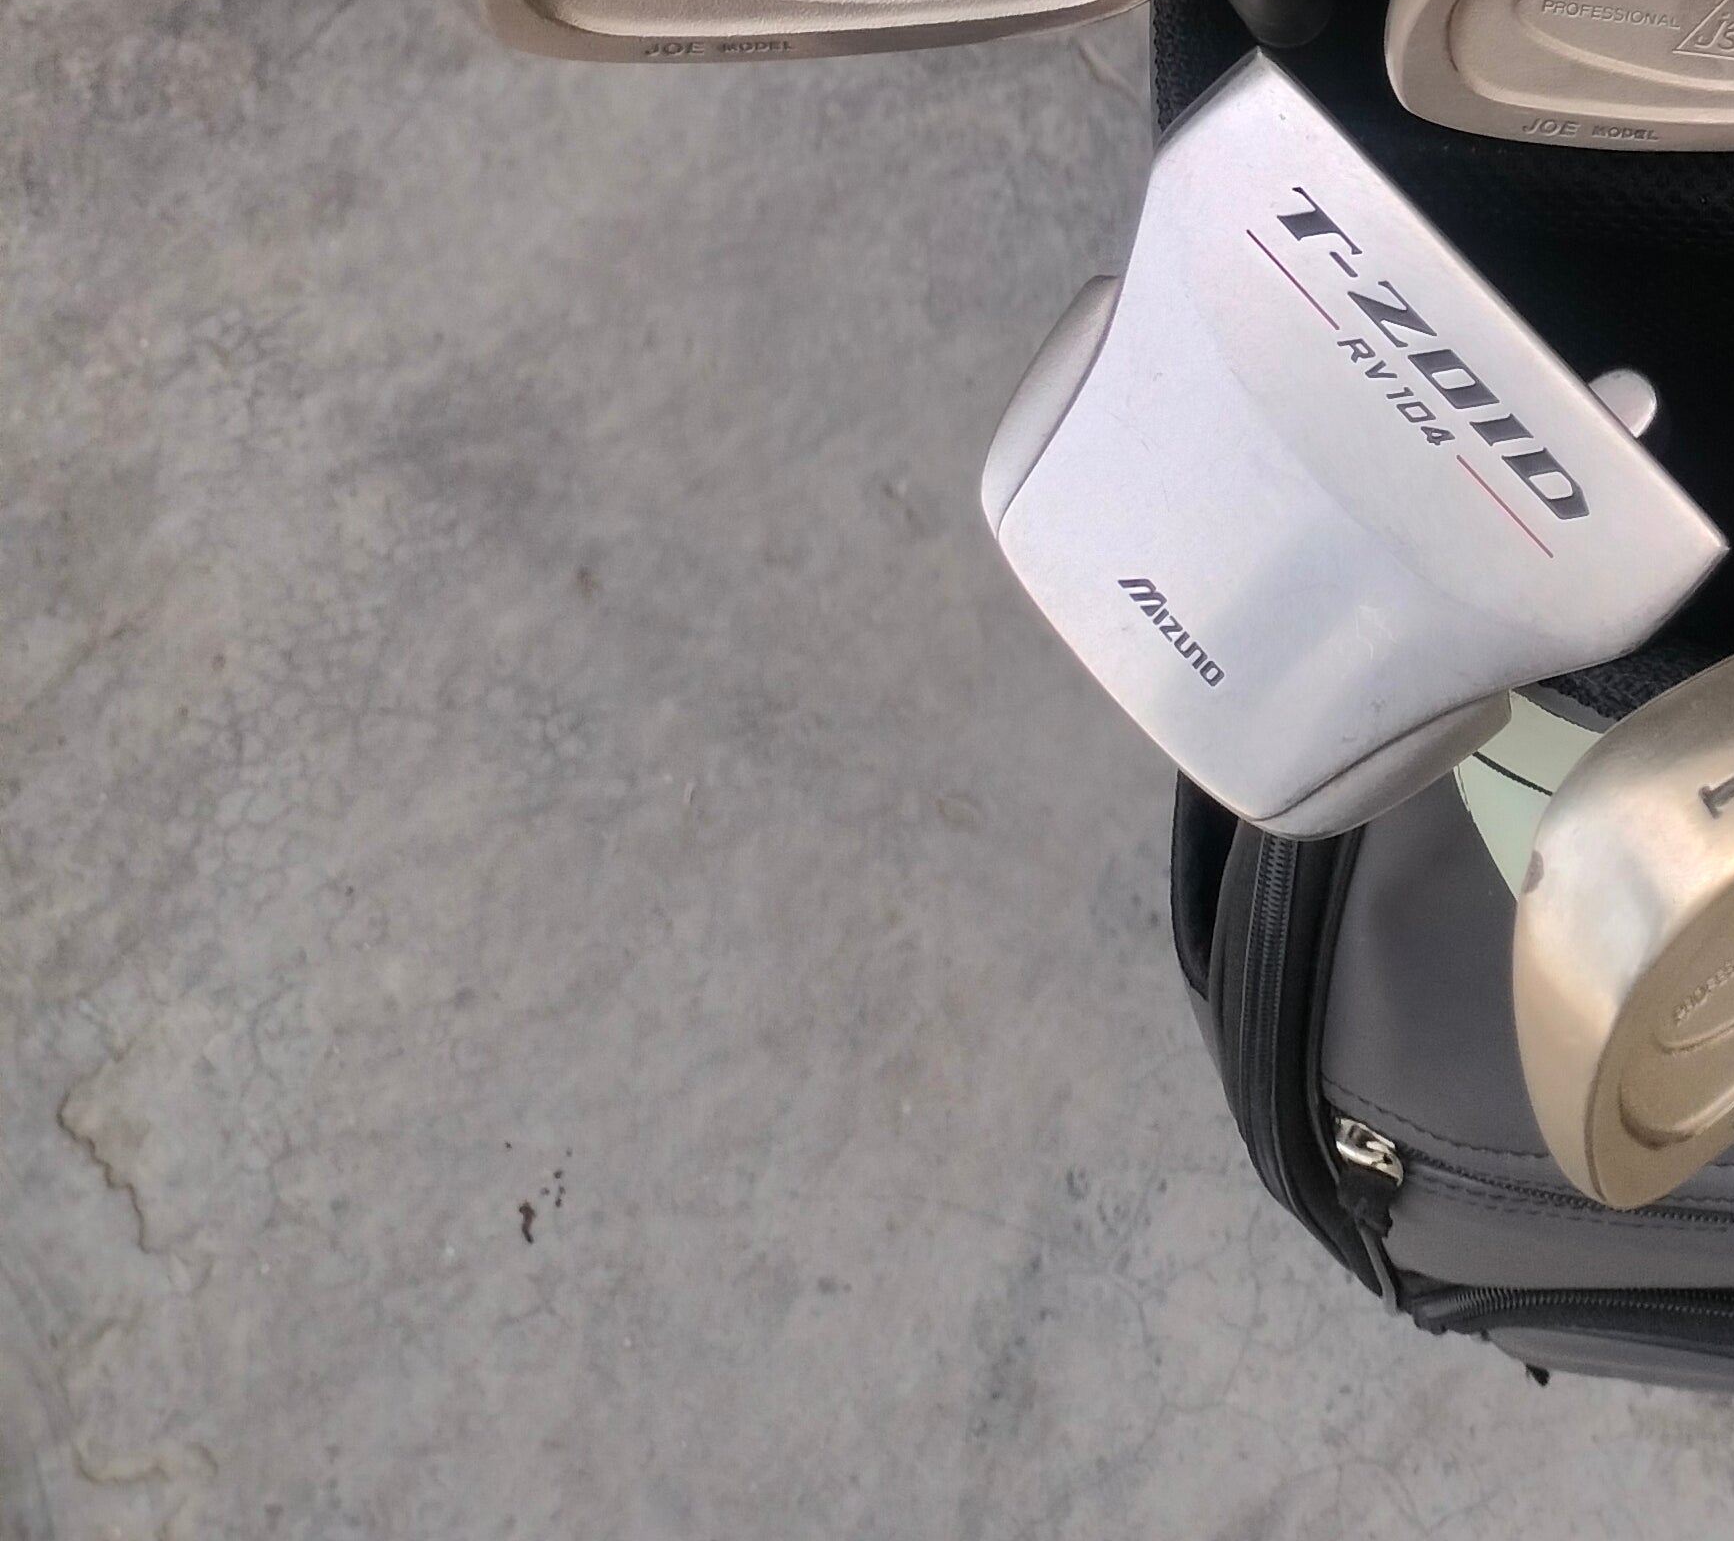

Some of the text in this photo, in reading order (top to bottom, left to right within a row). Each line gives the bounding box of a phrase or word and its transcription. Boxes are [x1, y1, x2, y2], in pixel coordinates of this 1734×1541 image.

[1541, 0, 1681, 30] PROFESSIONAL
[644, 40, 706, 57] JOE
[1522, 117, 1582, 138] JOE
[1276, 186, 1591, 521] T-ZOID
